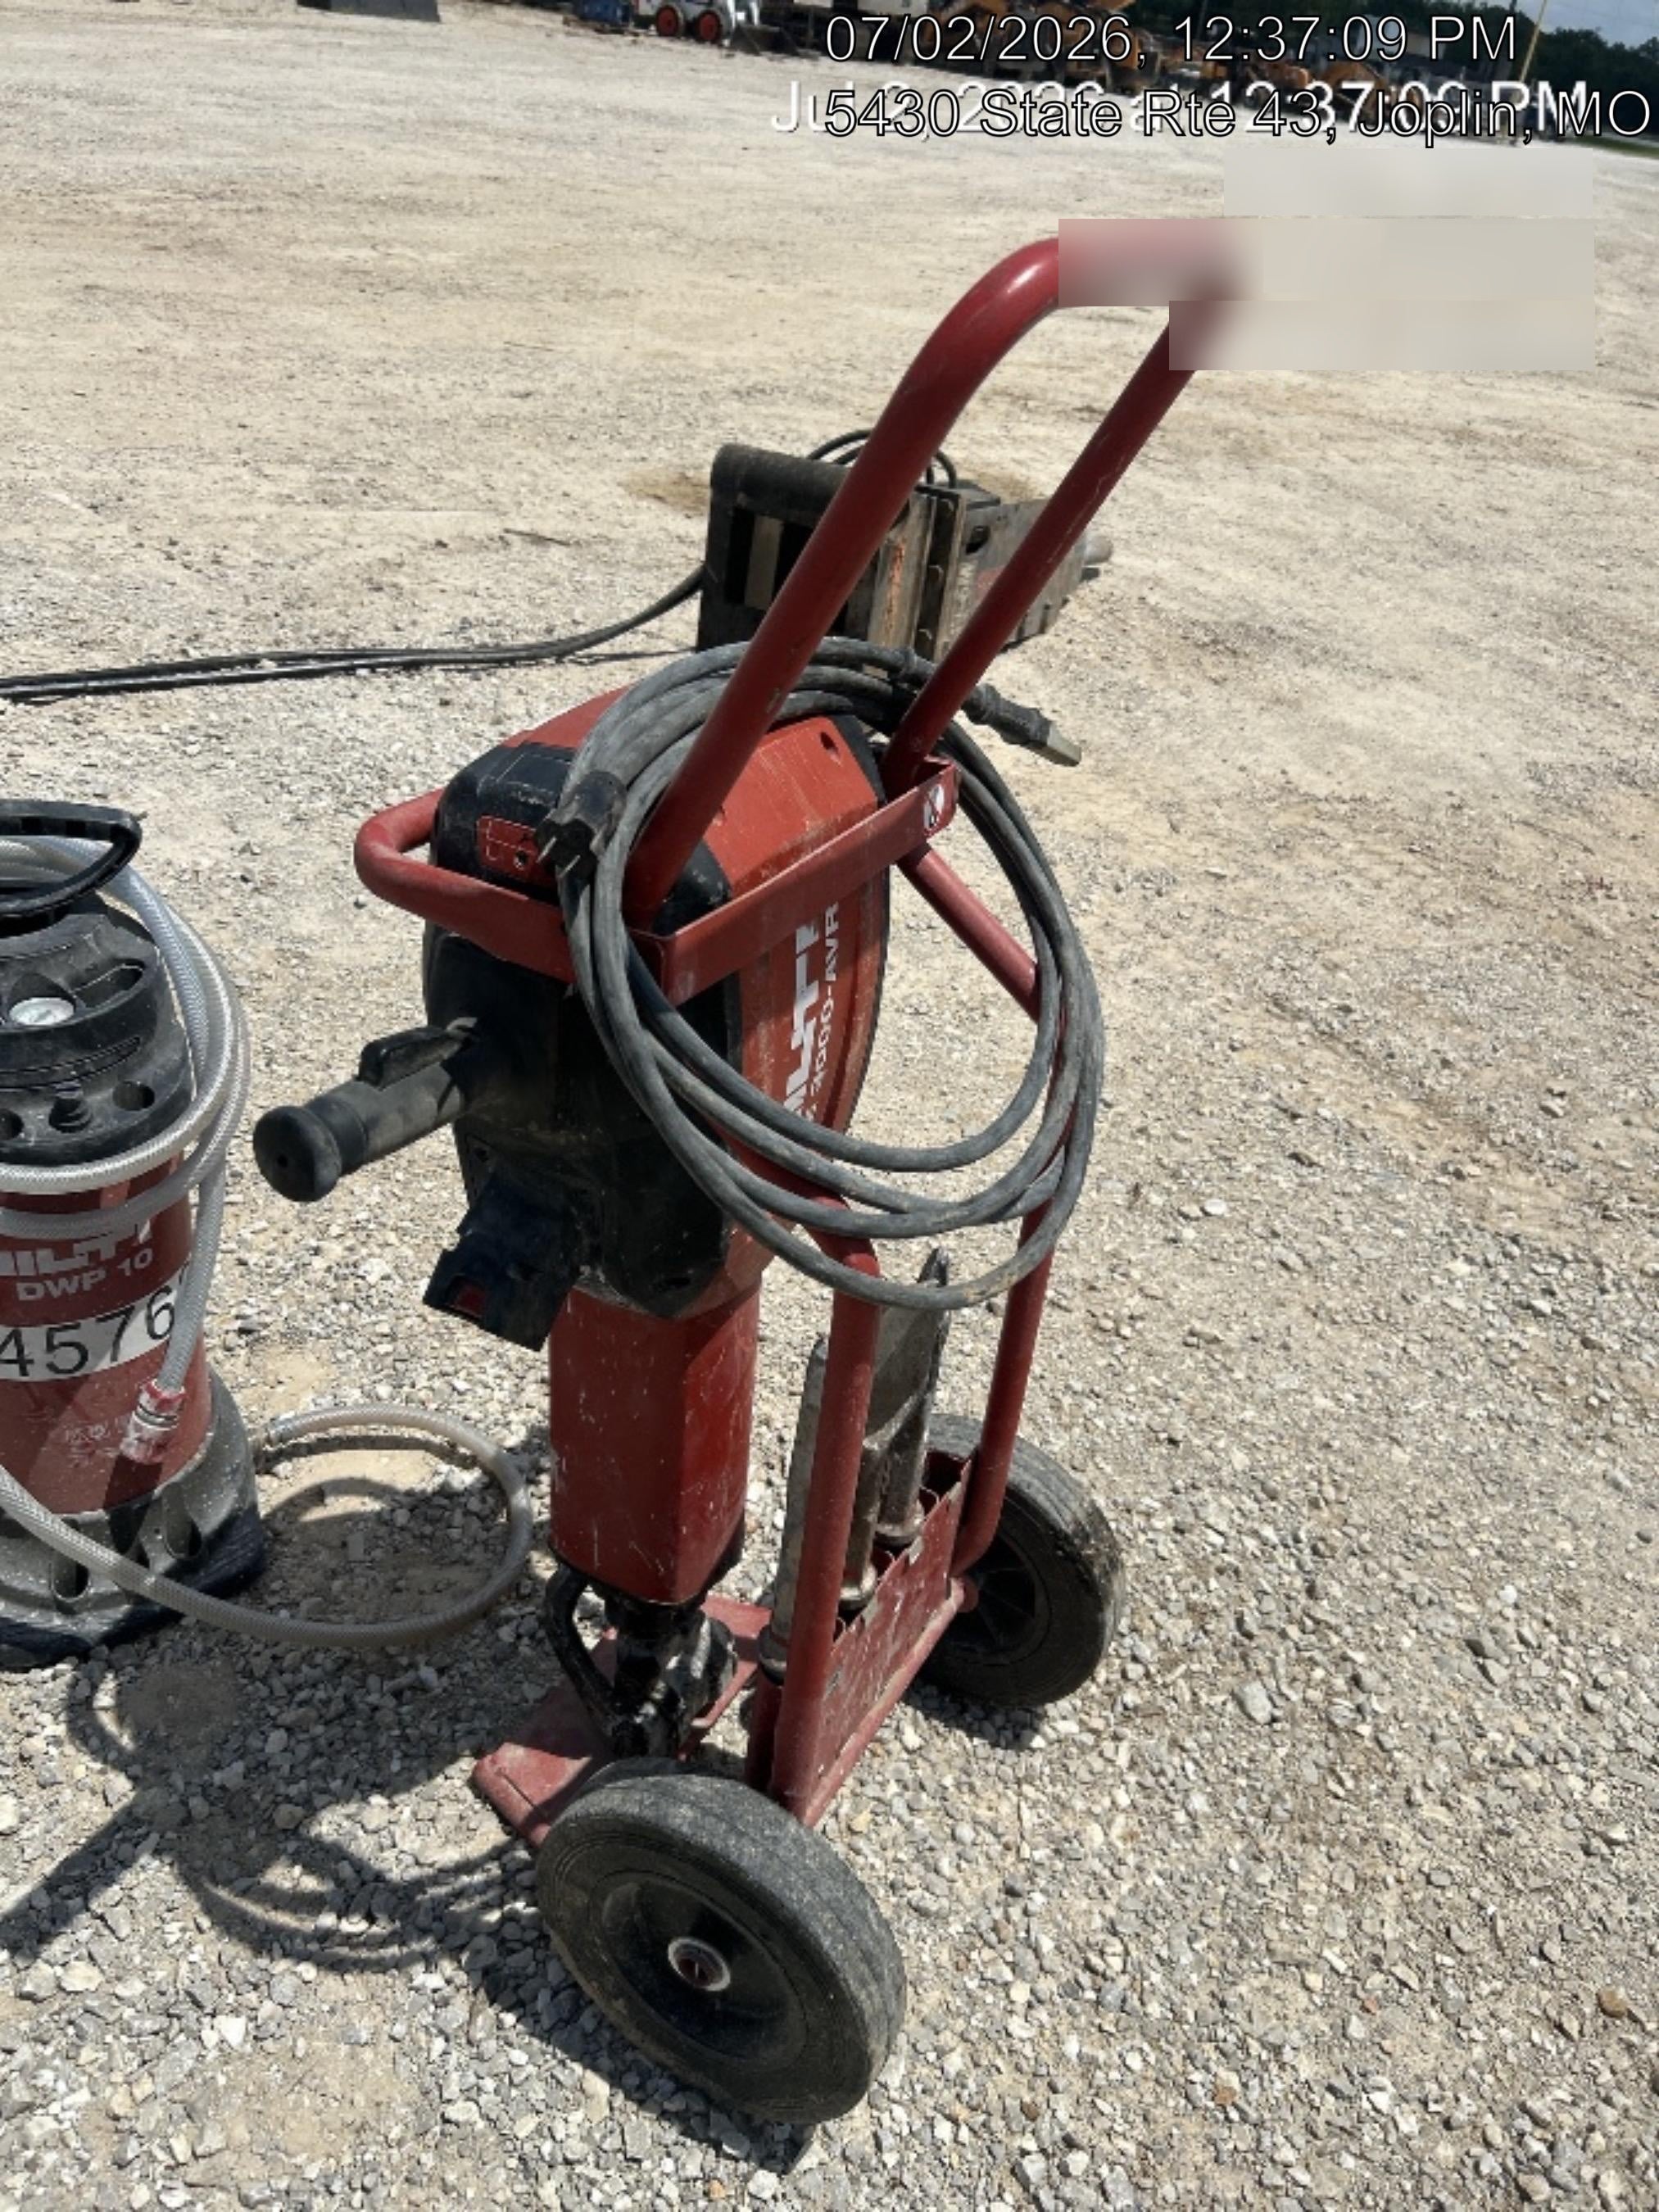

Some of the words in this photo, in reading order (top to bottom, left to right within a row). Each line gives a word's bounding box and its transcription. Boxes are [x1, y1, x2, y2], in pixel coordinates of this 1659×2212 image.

[16, 1270, 107, 1301] DWP
[117, 1247, 153, 1276] 10
[0, 1262, 188, 1377] 4576
